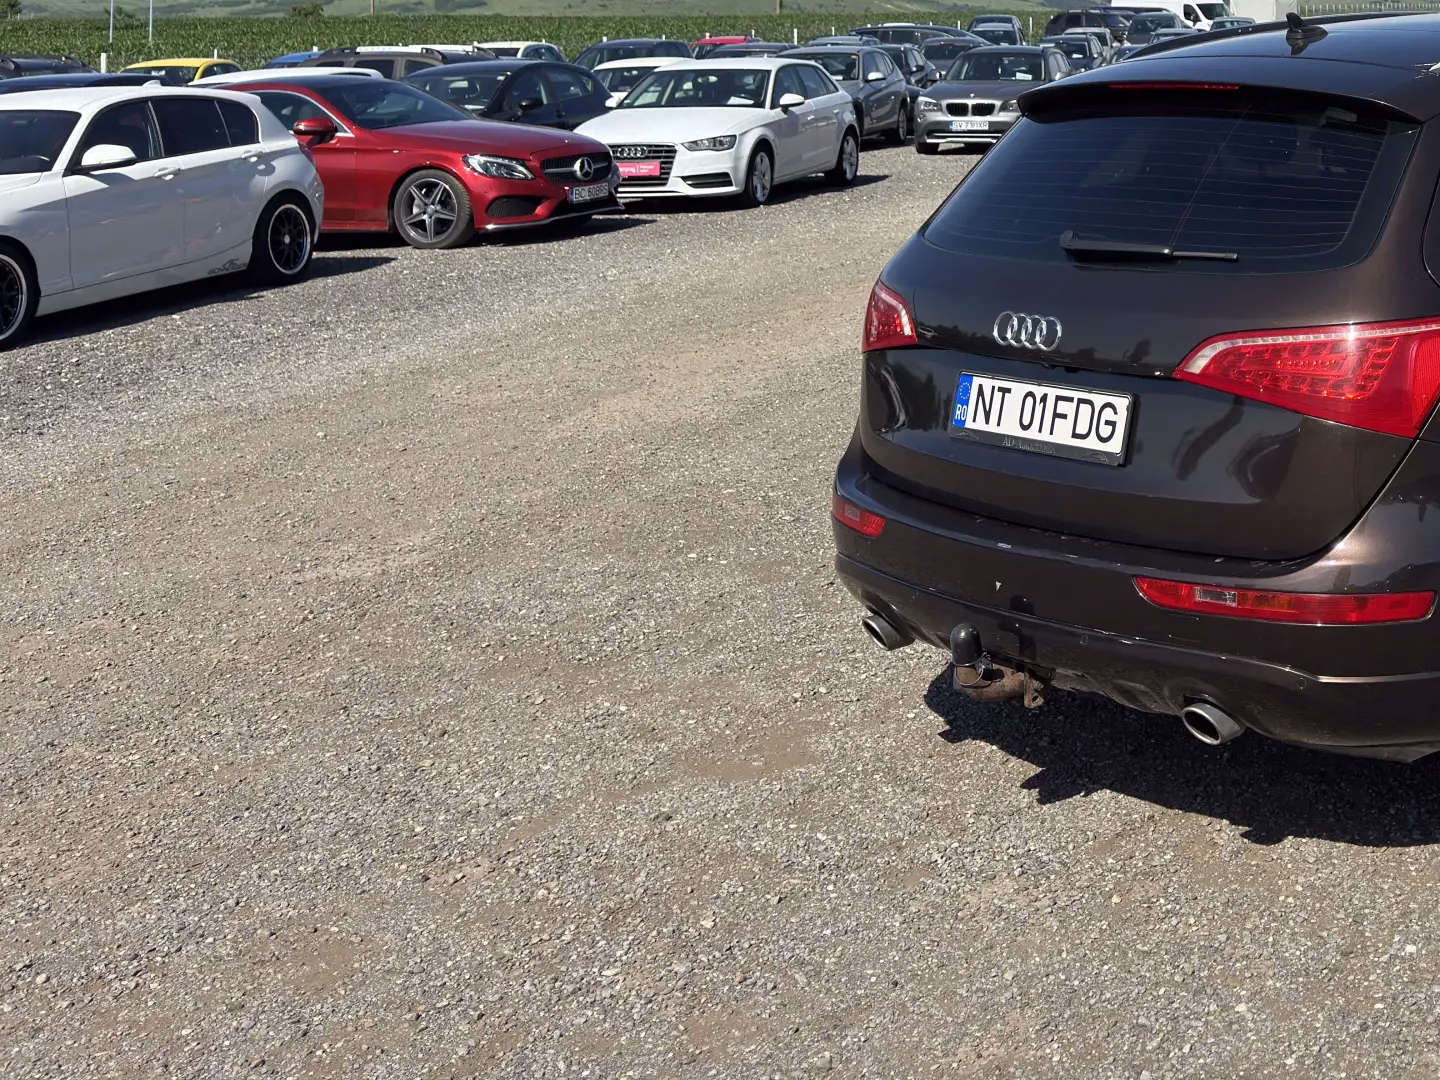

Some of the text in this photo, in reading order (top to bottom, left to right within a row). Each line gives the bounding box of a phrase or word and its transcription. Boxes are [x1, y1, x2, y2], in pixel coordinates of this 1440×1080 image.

[574, 188, 586, 200] BC
[955, 404, 968, 421] RO
[972, 383, 1118, 443] NT 01FDG
